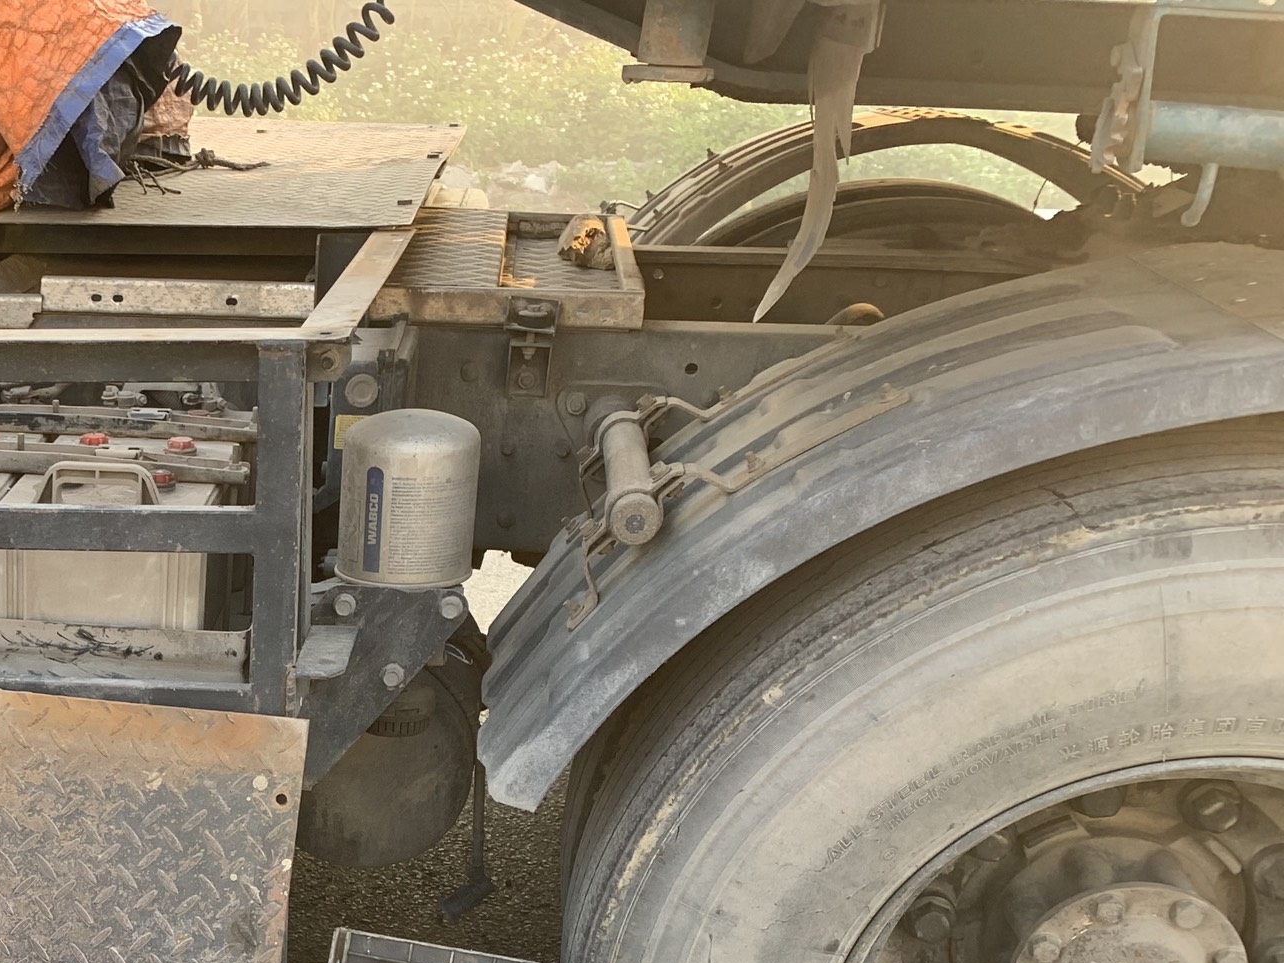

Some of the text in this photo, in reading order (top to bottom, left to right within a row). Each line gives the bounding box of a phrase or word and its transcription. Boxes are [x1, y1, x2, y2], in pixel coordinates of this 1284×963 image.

[367, 493, 379, 545] WABCO
[827, 824, 865, 865] ALL
[867, 766, 943, 823] STEEL
[883, 723, 1068, 832] REGROOVABLE
